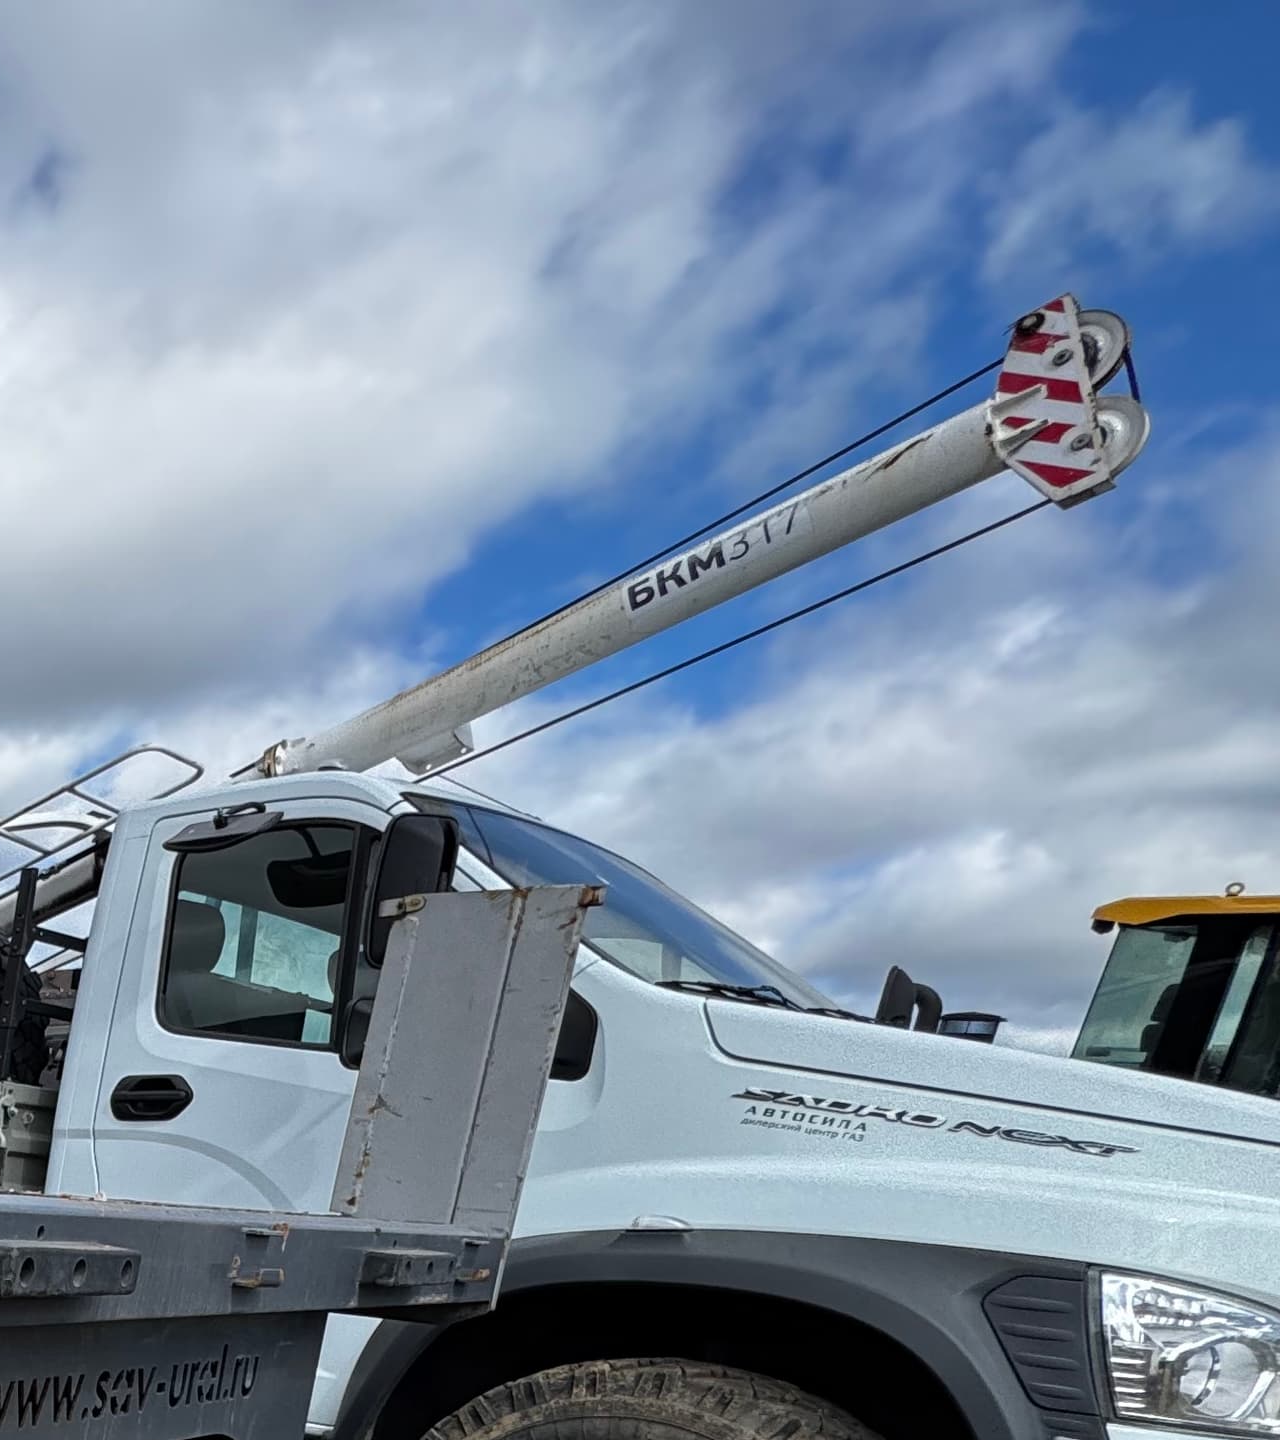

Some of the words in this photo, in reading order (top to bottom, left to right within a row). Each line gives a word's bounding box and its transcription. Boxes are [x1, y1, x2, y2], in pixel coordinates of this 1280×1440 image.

[740, 1117, 802, 1132] дилерский
[804, 1126, 840, 1140] центр
[841, 1131, 864, 1142] ГАЗ
[744, 1105, 867, 1132] АВТОСИЛА
